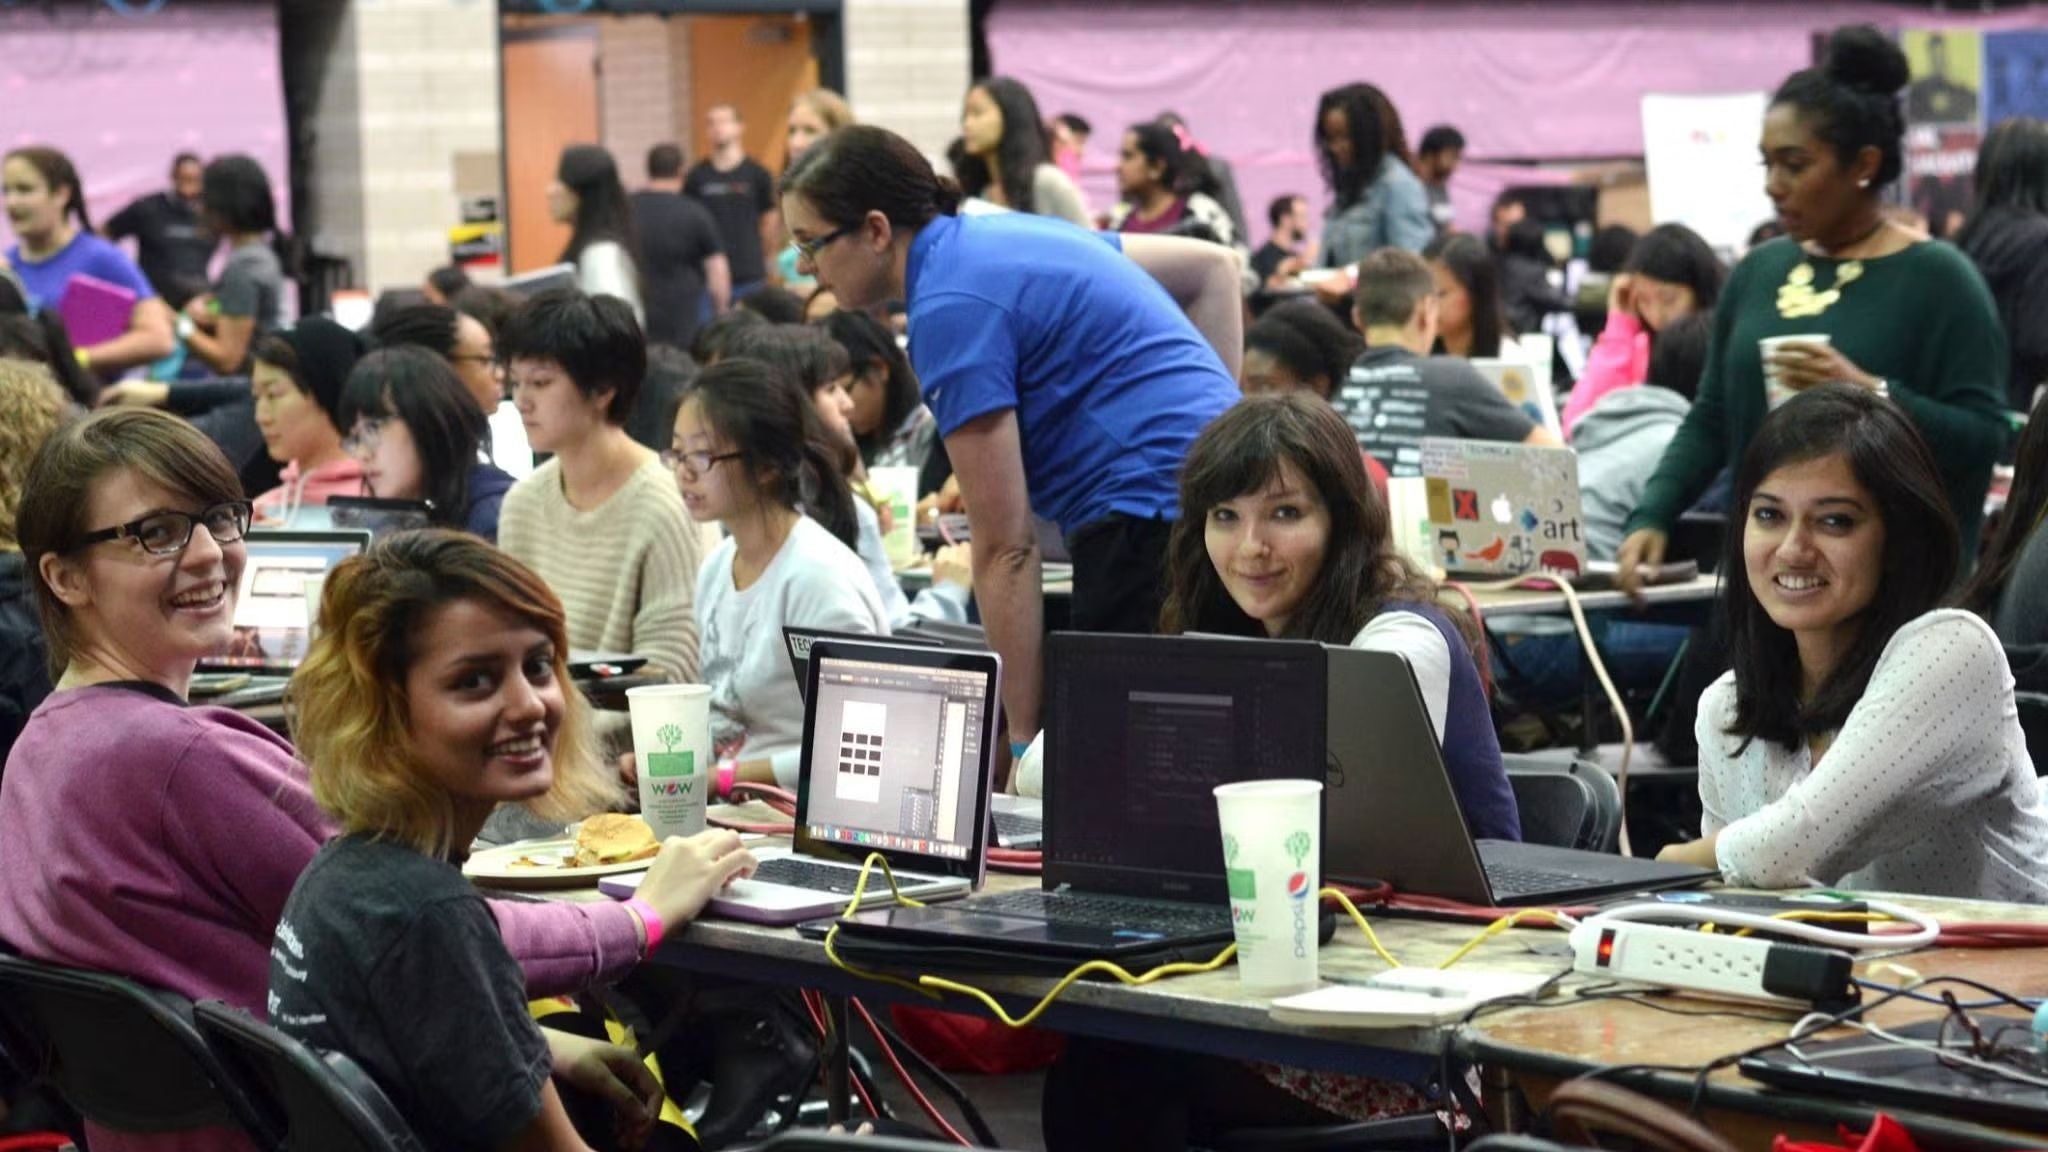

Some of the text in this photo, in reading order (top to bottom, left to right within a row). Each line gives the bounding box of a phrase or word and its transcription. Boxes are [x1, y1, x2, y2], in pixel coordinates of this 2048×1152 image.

[1543, 516, 1580, 541] art
[650, 781, 693, 796] WOW
[1232, 906, 1256, 922] OW
[1292, 902, 1307, 960] pepsi
